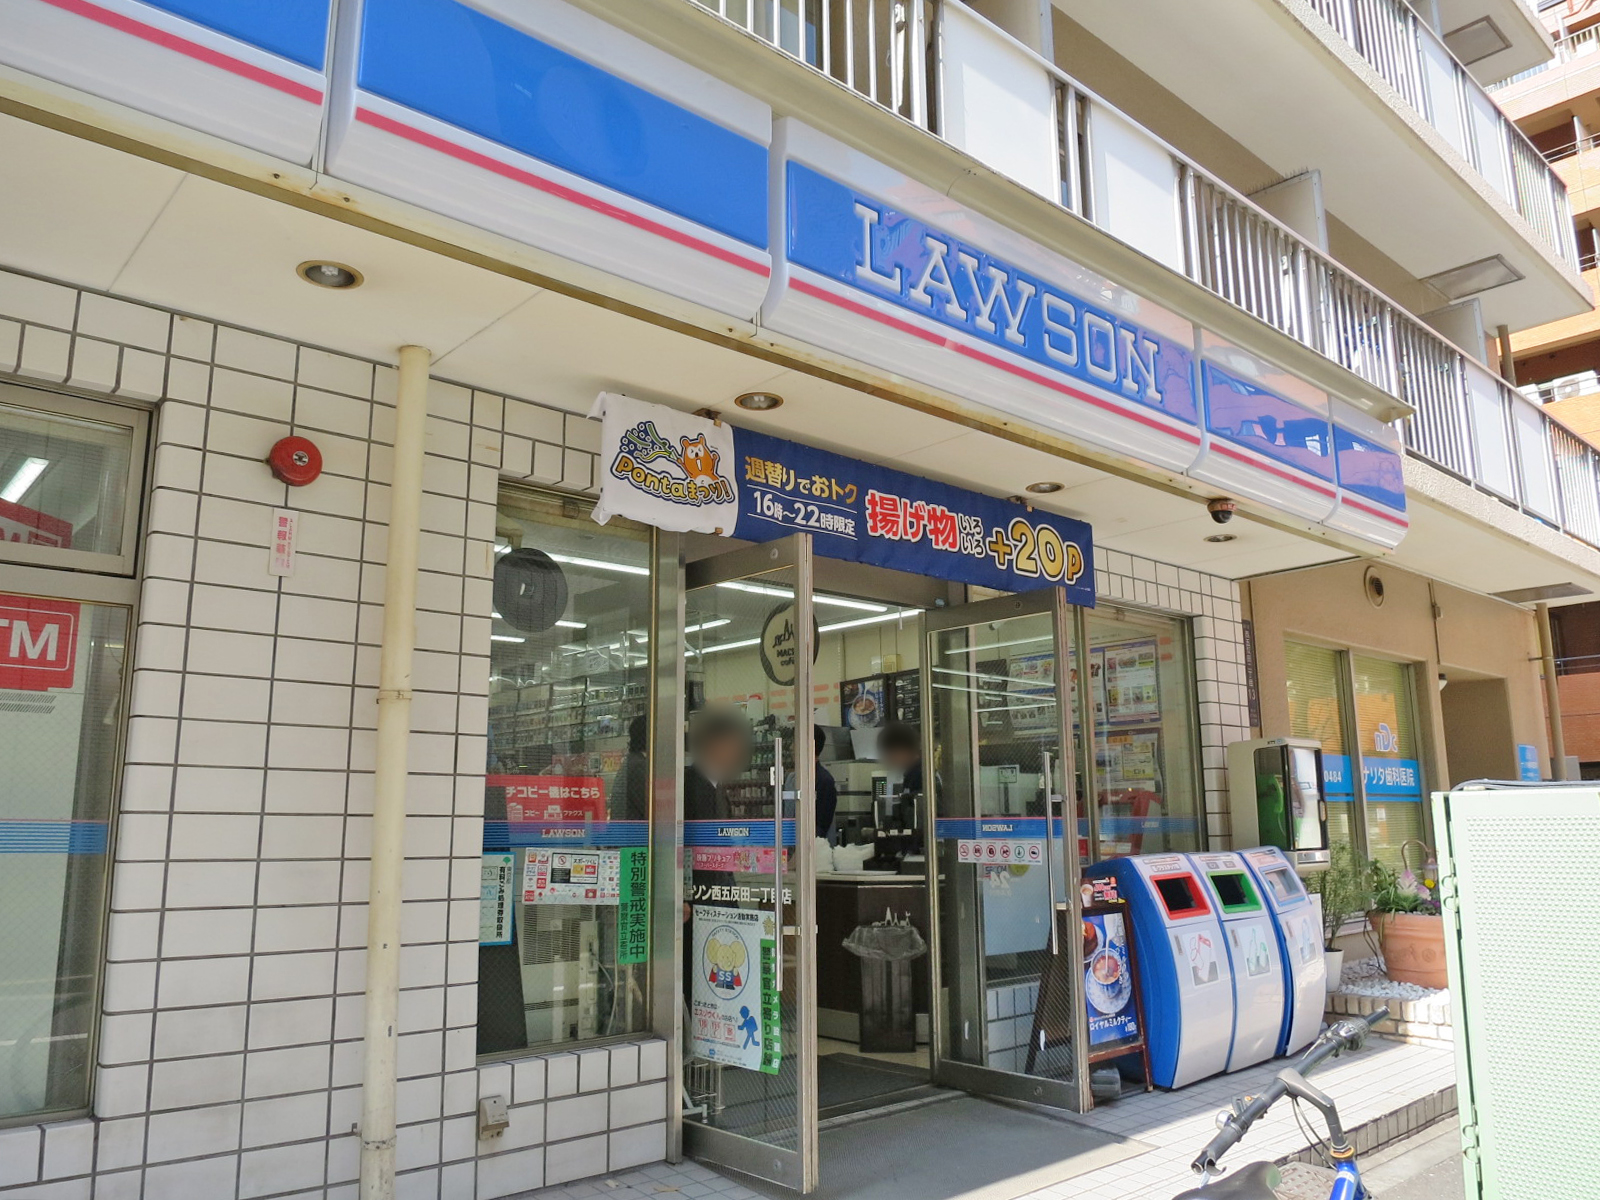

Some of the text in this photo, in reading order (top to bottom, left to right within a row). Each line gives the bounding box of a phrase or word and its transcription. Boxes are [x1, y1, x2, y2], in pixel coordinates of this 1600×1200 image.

[854, 201, 1164, 403] LAWSON
[745, 456, 858, 504] 週替りでおトク
[866, 490, 959, 552] 揚げ物
[958, 513, 983, 537] いろ
[961, 535, 985, 557] いろ
[1362, 766, 1415, 786] ナリタ歯科医院
[541, 828, 585, 838] LAWSON
[717, 827, 749, 837] LAWSON
[629, 851, 647, 960] 特別警戒実施中
[718, 971, 732, 982] SS
